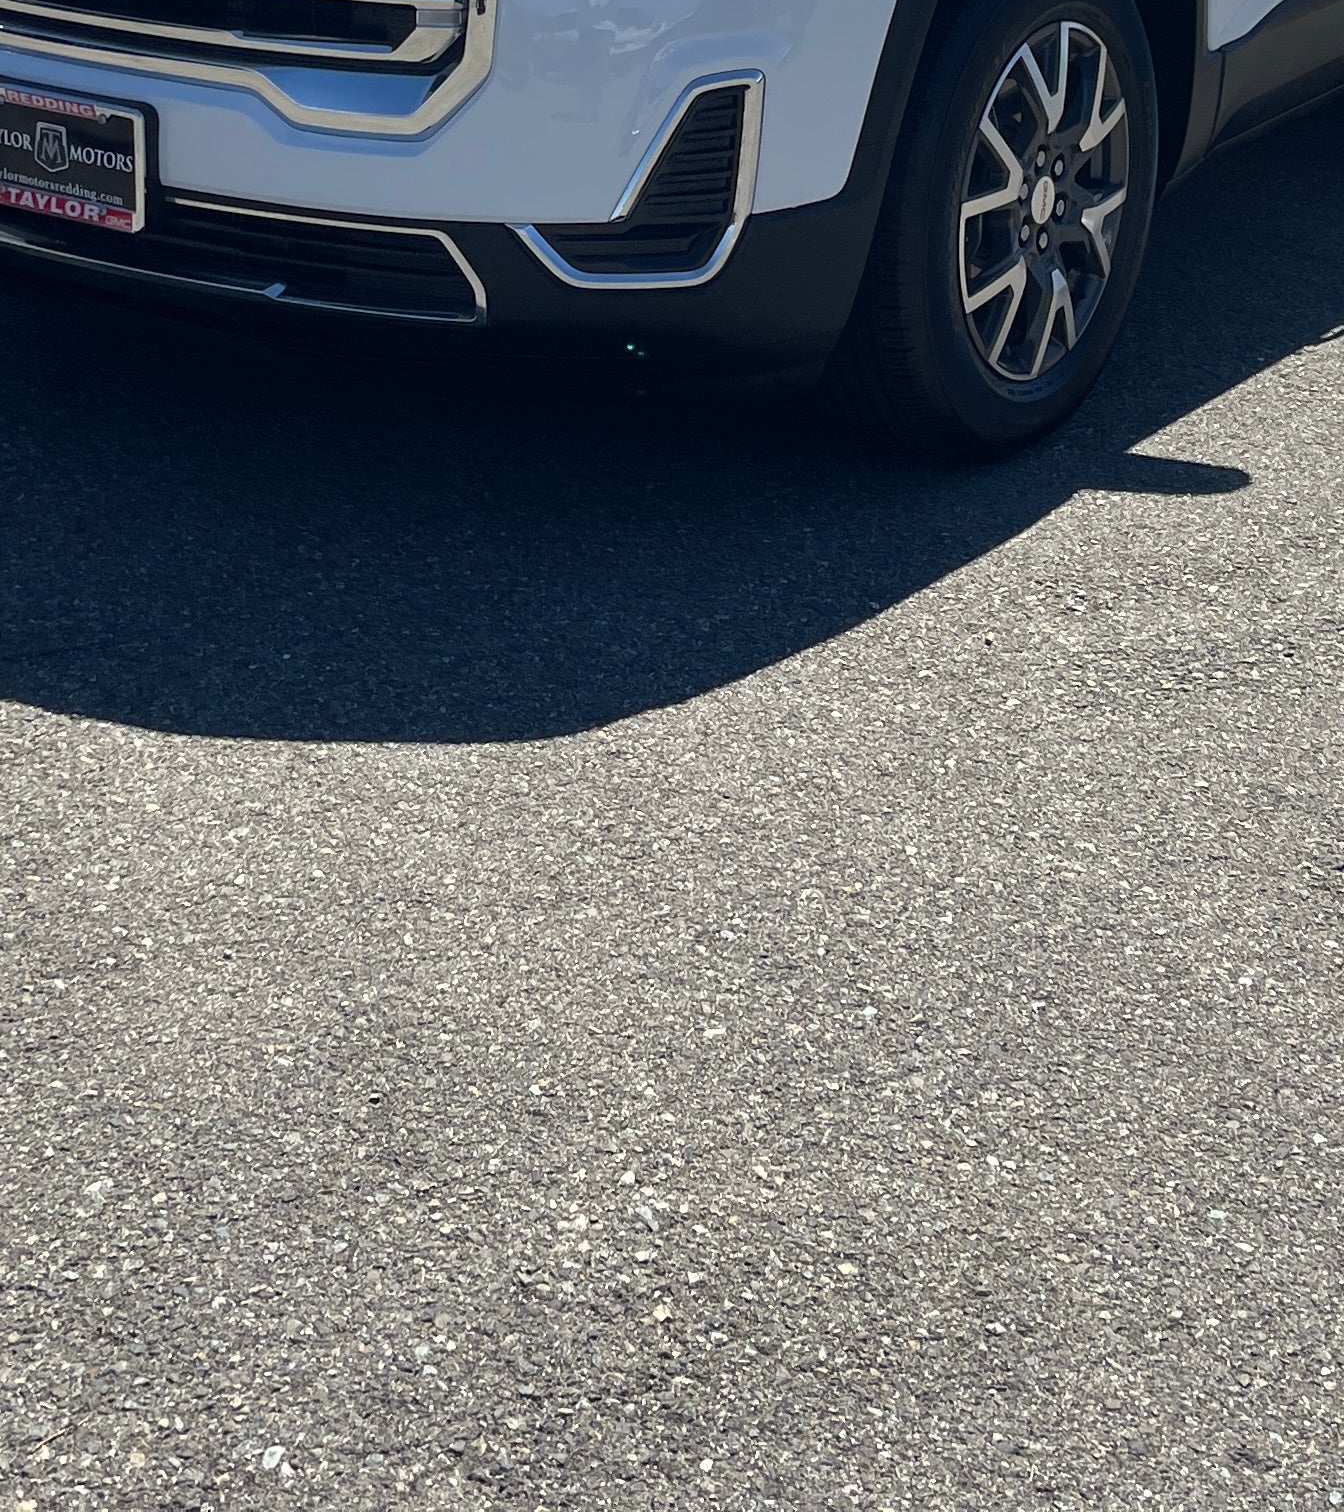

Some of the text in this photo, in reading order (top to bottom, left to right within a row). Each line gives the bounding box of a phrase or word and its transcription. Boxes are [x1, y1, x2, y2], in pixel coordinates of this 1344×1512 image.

[6, 90, 96, 117] REDDING
[69, 144, 134, 173] MOTORS
[7, 187, 102, 222] TAYLOR
